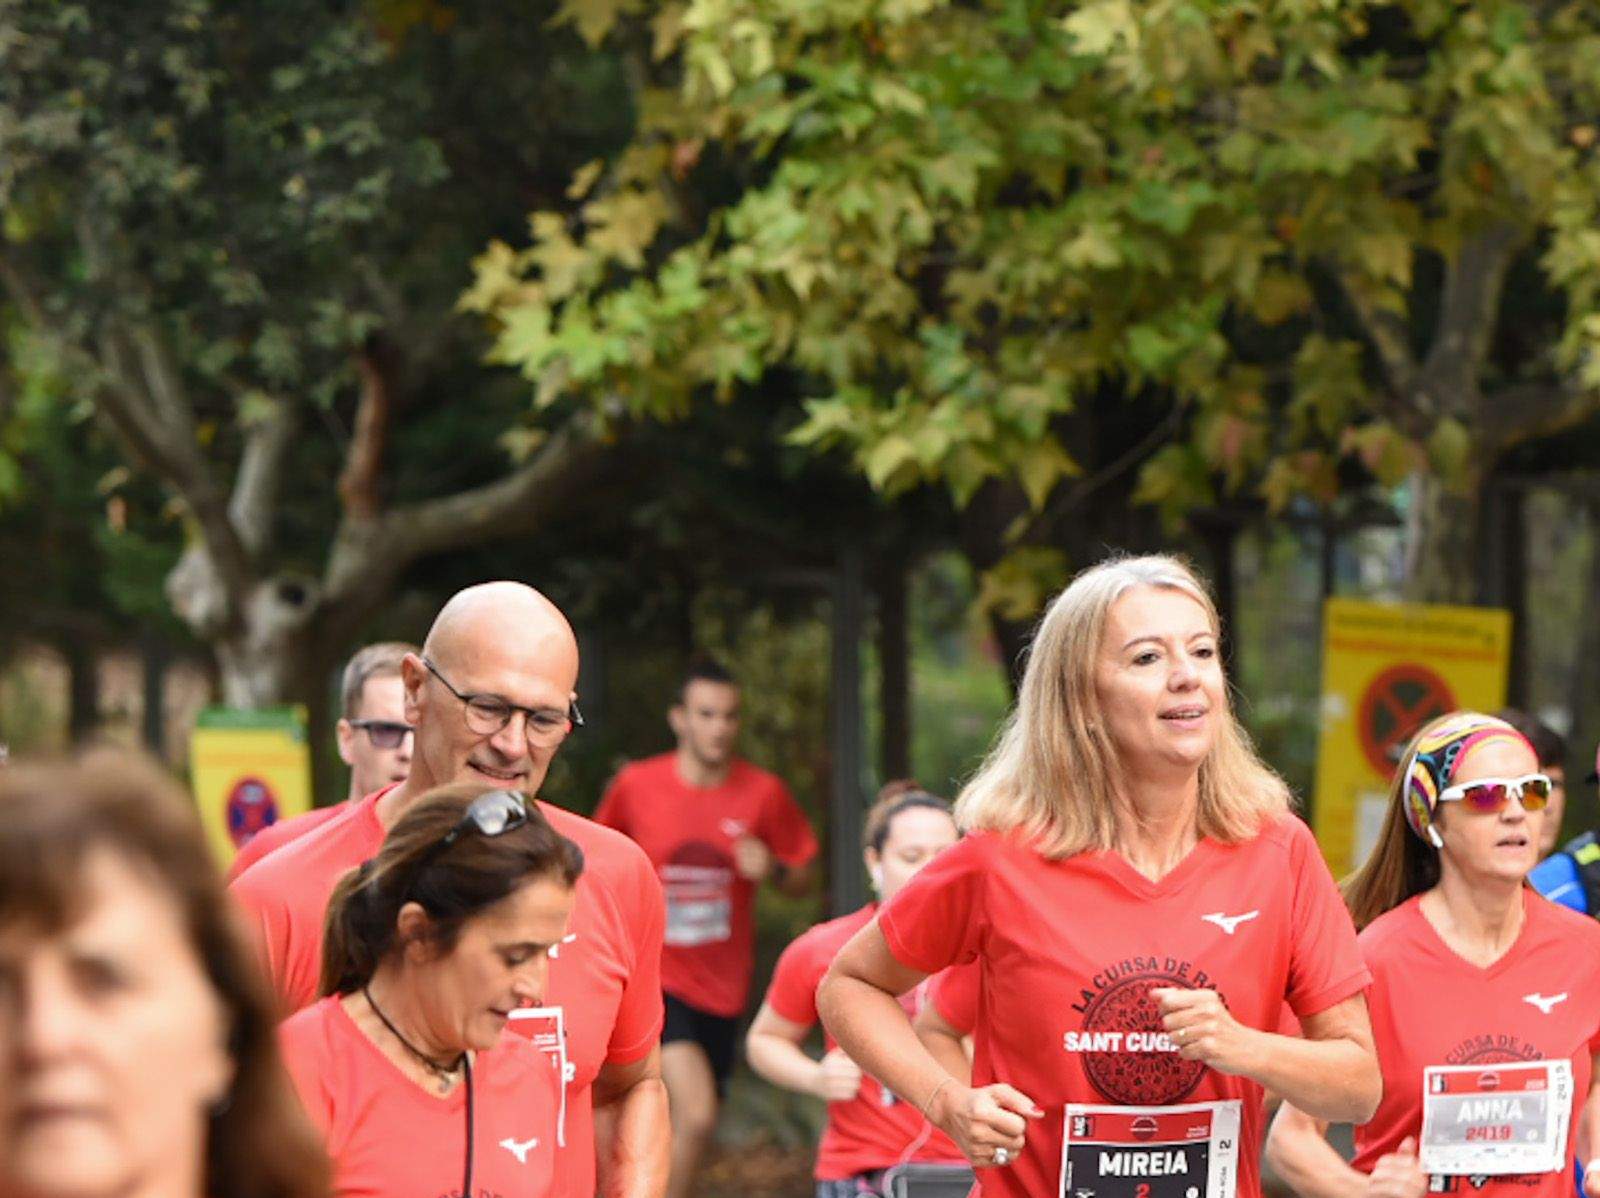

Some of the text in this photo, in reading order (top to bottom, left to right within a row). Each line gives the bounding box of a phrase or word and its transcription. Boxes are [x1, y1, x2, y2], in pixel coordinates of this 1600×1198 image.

[1072, 988, 1096, 1014] LA
[1093, 957, 1159, 990] CURSA
[1164, 958, 1192, 978] DE
[1063, 1031, 1124, 1053] SANT
[1499, 1035, 1519, 1050] DE
[1456, 1100, 1523, 1123] ANNA
[1465, 1125, 1513, 1141] 2419
[1099, 1150, 1189, 1177] MIREIA
